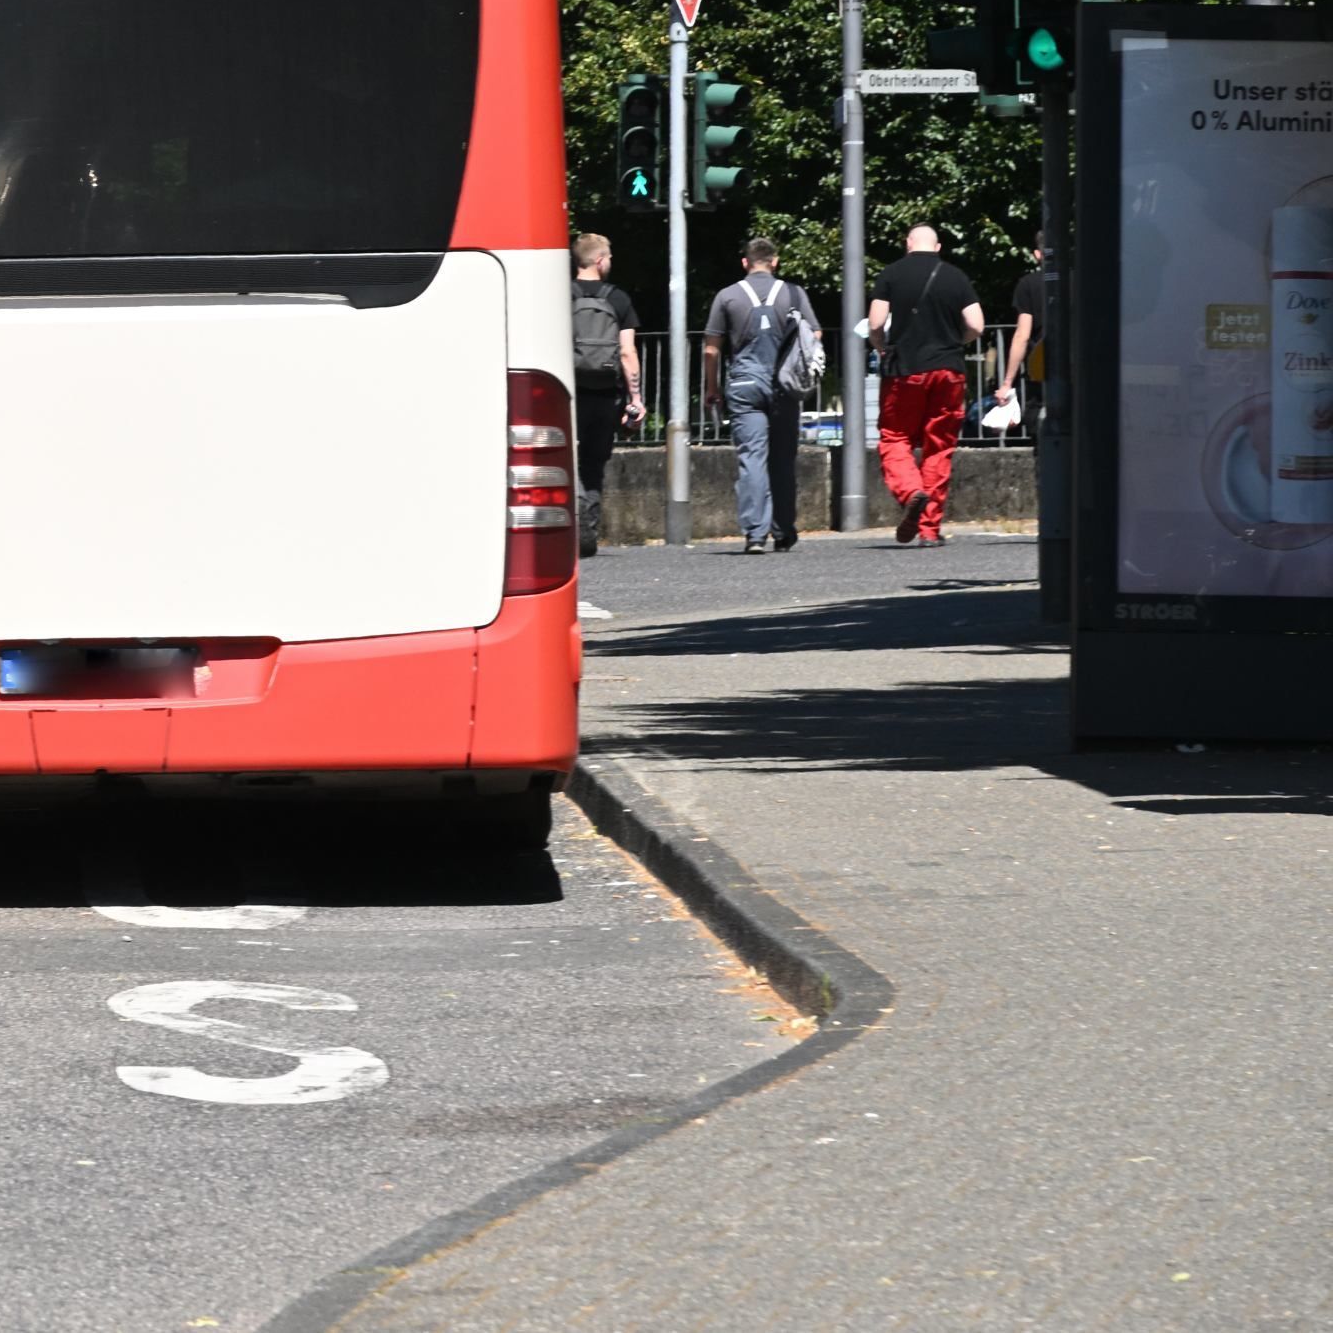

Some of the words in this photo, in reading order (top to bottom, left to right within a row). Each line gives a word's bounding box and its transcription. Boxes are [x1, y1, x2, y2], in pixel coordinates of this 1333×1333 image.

[869, 74, 959, 90] Oberheidkamper
[1214, 78, 1288, 101] Unser
[1235, 109, 1333, 133] Alumini
[1286, 290, 1333, 311] Dove
[1212, 329, 1268, 343] testen
[1284, 351, 1333, 372] Zink
